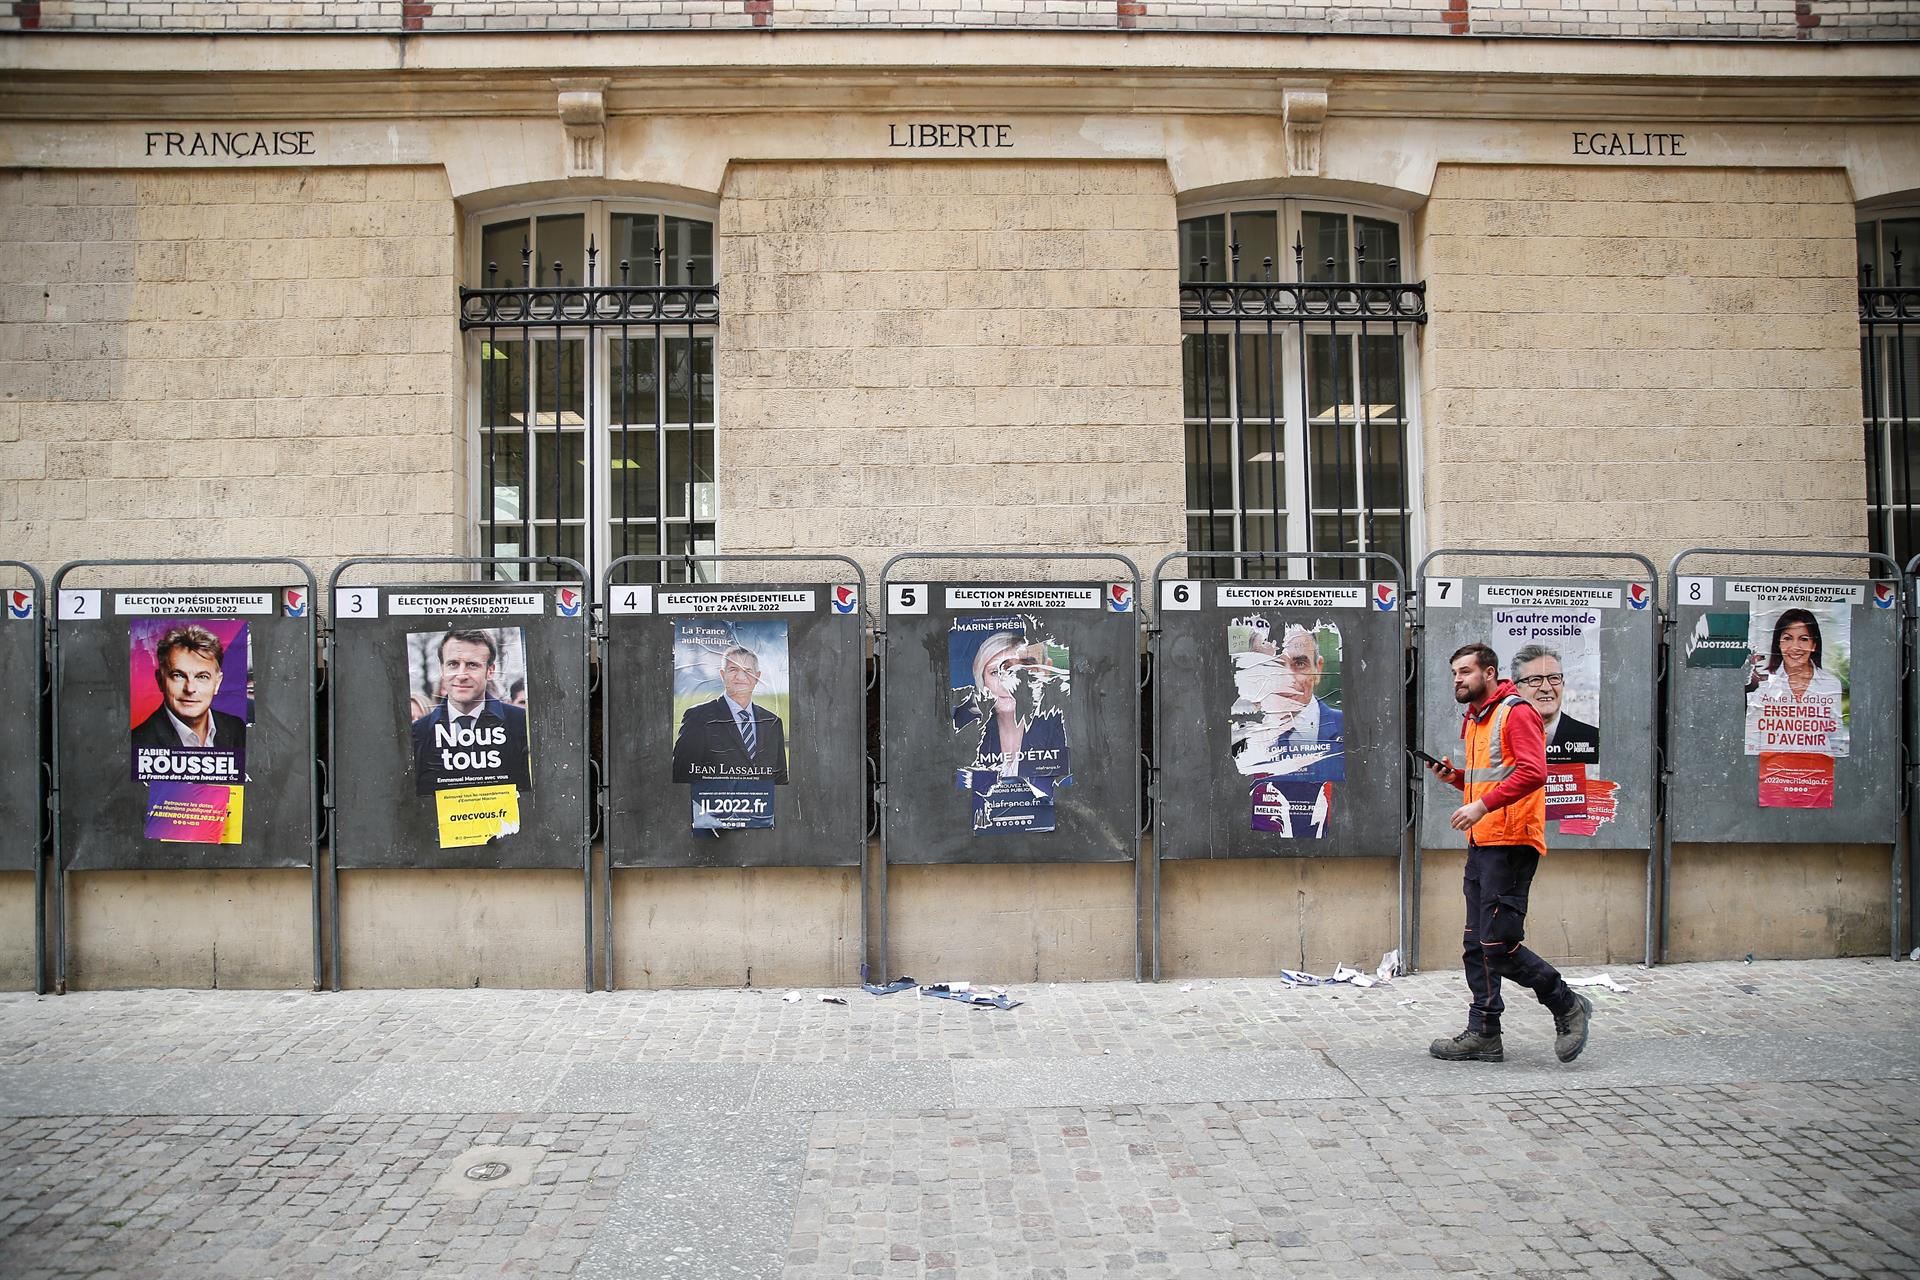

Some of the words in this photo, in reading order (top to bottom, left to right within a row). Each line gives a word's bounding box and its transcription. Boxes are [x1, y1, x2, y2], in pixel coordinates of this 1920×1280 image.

[889, 124, 1014, 148] LIBERTE
[145, 131, 316, 159] FRANÇAISE
[1573, 132, 1687, 156] EGALITE
[954, 590, 1005, 599] ÉLECTION
[1007, 590, 1092, 599] PRÉSIDENTIELLE
[1173, 585, 1190, 603] 6
[1226, 588, 1275, 598] ÉLECTION
[1277, 589, 1358, 599] PRÉSIDENTIELLE
[1437, 581, 1452, 600] 7
[1487, 587, 1533, 596] ÉLECTION
[1536, 588, 1613, 599] PRÉSIDENTIELLE
[1689, 582, 1701, 600] 8
[1734, 584, 1780, 594] ÉLECTION
[1781, 585, 1858, 595] PRÉSIDENTIELLE
[124, 596, 175, 605] ÉLECTION
[177, 596, 264, 605] PRÉSIDENTIELLE
[397, 596, 448, 606] ÉLECTION
[451, 596, 536, 606] PRÉSIDENTIELLE
[623, 591, 638, 610] 4
[667, 594, 718, 604] ÉLECTION
[720, 593, 806, 603] PRÉSIDENTIELLE
[900, 588, 916, 606] 5
[1778, 594, 1788, 602] 24
[74, 595, 86, 614] 2
[350, 594, 363, 614] 3
[424, 606, 434, 614] 10
[447, 606, 459, 614] 24
[460, 606, 487, 614] AVRIL
[489, 606, 510, 614] 2022
[980, 600, 991, 608] 10
[1003, 600, 1015, 608] 24
[1016, 600, 1044, 608] AVRIL
[1045, 600, 1066, 608] 2022
[1497, 612, 1513, 623] Un
[1516, 612, 1549, 624] autre
[1552, 612, 1597, 624] monde
[681, 627, 694, 635] La
[696, 627, 726, 636] France
[957, 622, 994, 632] MARINE
[1508, 625, 1528, 636] est
[1531, 624, 1582, 639] possible
[681, 637, 732, 647] authentique
[1696, 641, 1749, 649] ADOT2022.F
[1764, 705, 1831, 719] ENSEMBLE
[1758, 718, 1837, 732] CHANGEONS
[435, 722, 507, 749] Nous
[1767, 732, 1826, 746] D'AVENIR
[138, 748, 170, 756] FABIEN
[1016, 748, 1060, 761] D'ÉTAT
[138, 756, 239, 775] ROUSSEL
[441, 748, 502, 771] tous
[688, 763, 716, 774] JEAN
[719, 763, 773, 776] LASSALLE
[1558, 774, 1574, 782] TOUS
[1565, 783, 1577, 792] SUR
[699, 798, 768, 816] JL2022.fr
[449, 808, 507, 822] avecvous.fr
